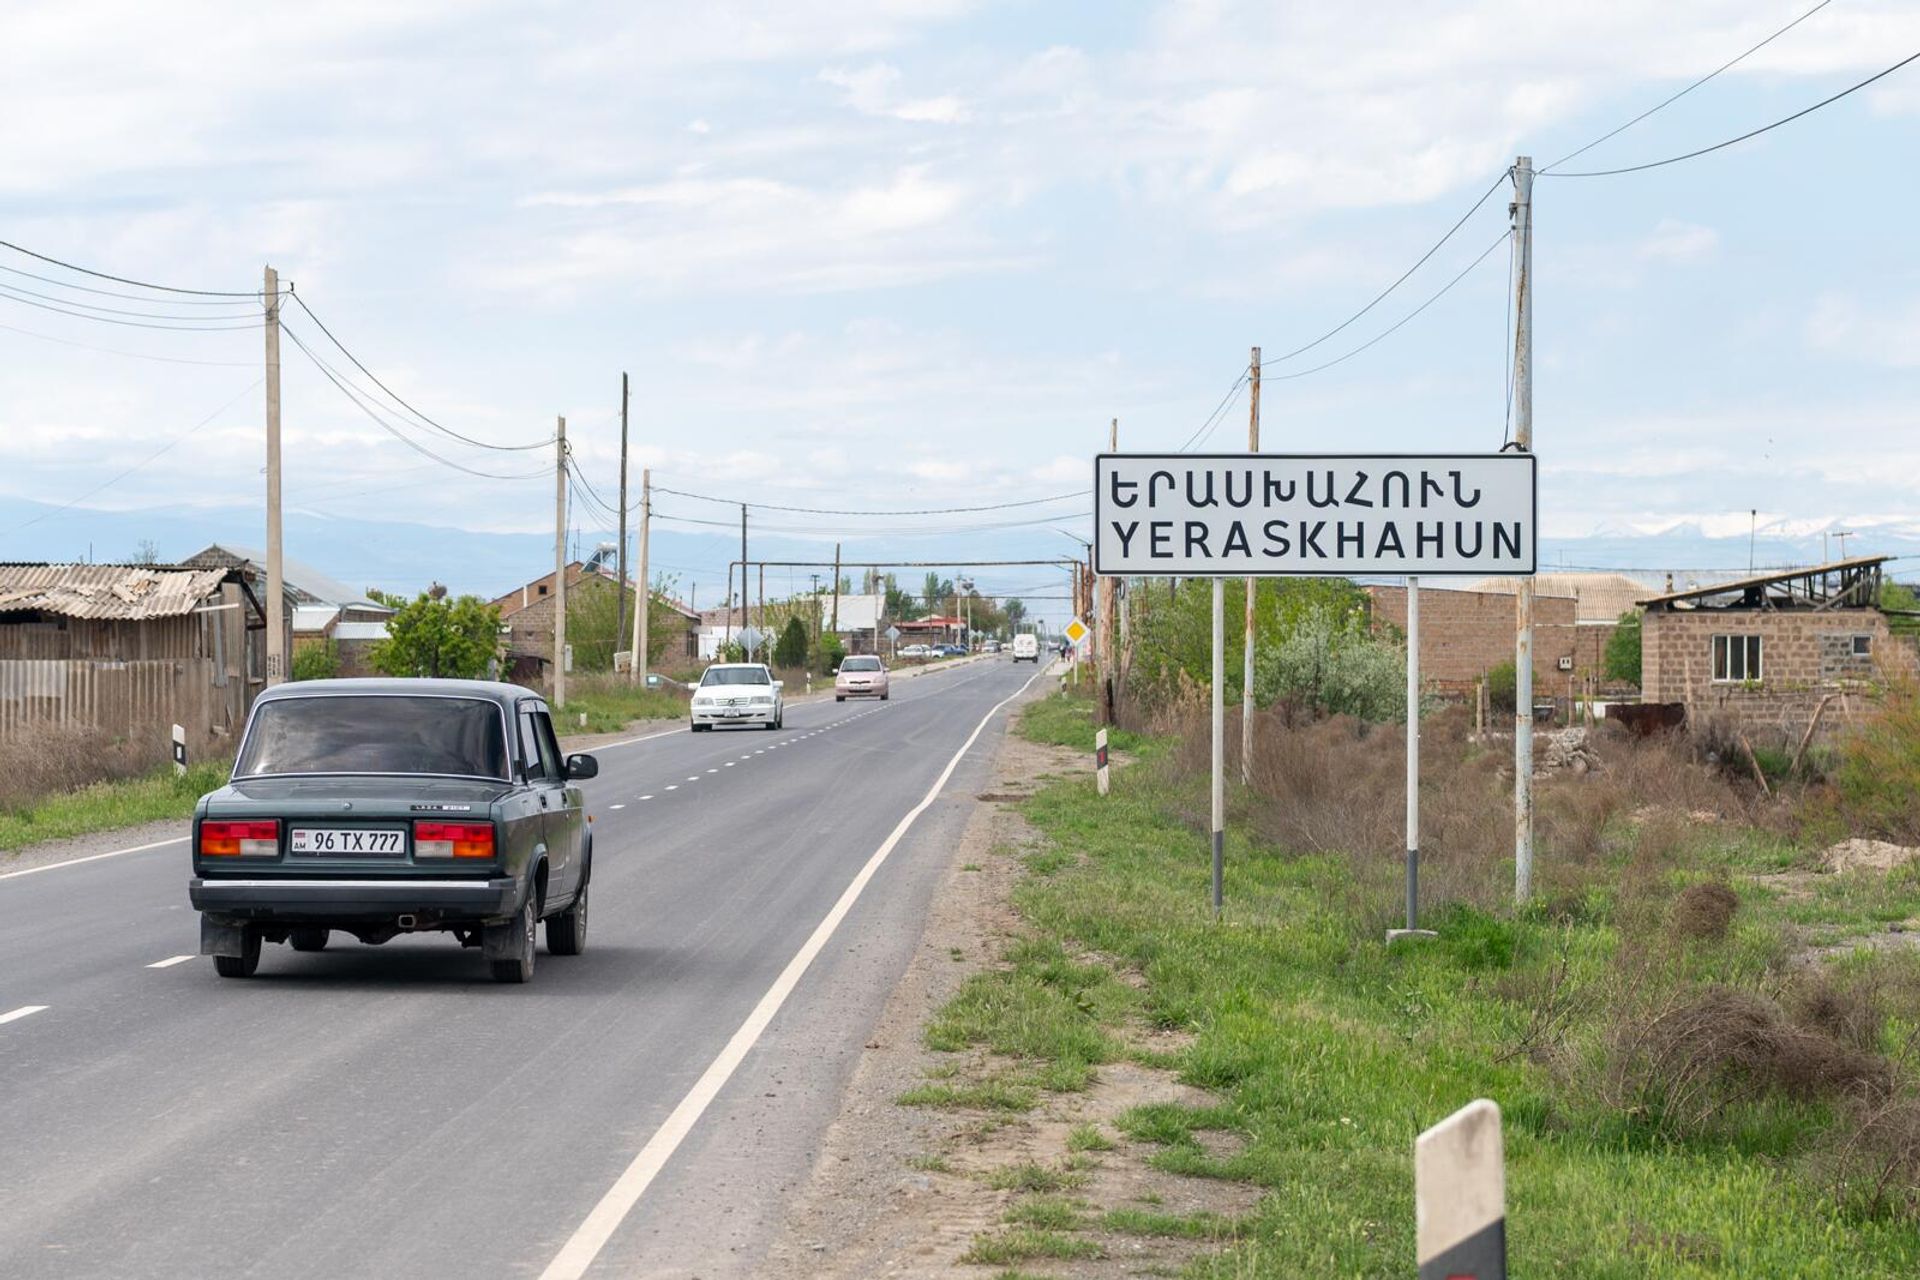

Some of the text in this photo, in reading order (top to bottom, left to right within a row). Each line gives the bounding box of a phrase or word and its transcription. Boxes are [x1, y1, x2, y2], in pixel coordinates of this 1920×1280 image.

[1111, 470, 1481, 509] ԵՐԱՍԽԱՀՈՒՆ
[1111, 519, 1521, 559] YERASKHAHUN
[294, 842, 306, 850] AM
[315, 832, 399, 851] 96 TX 777
